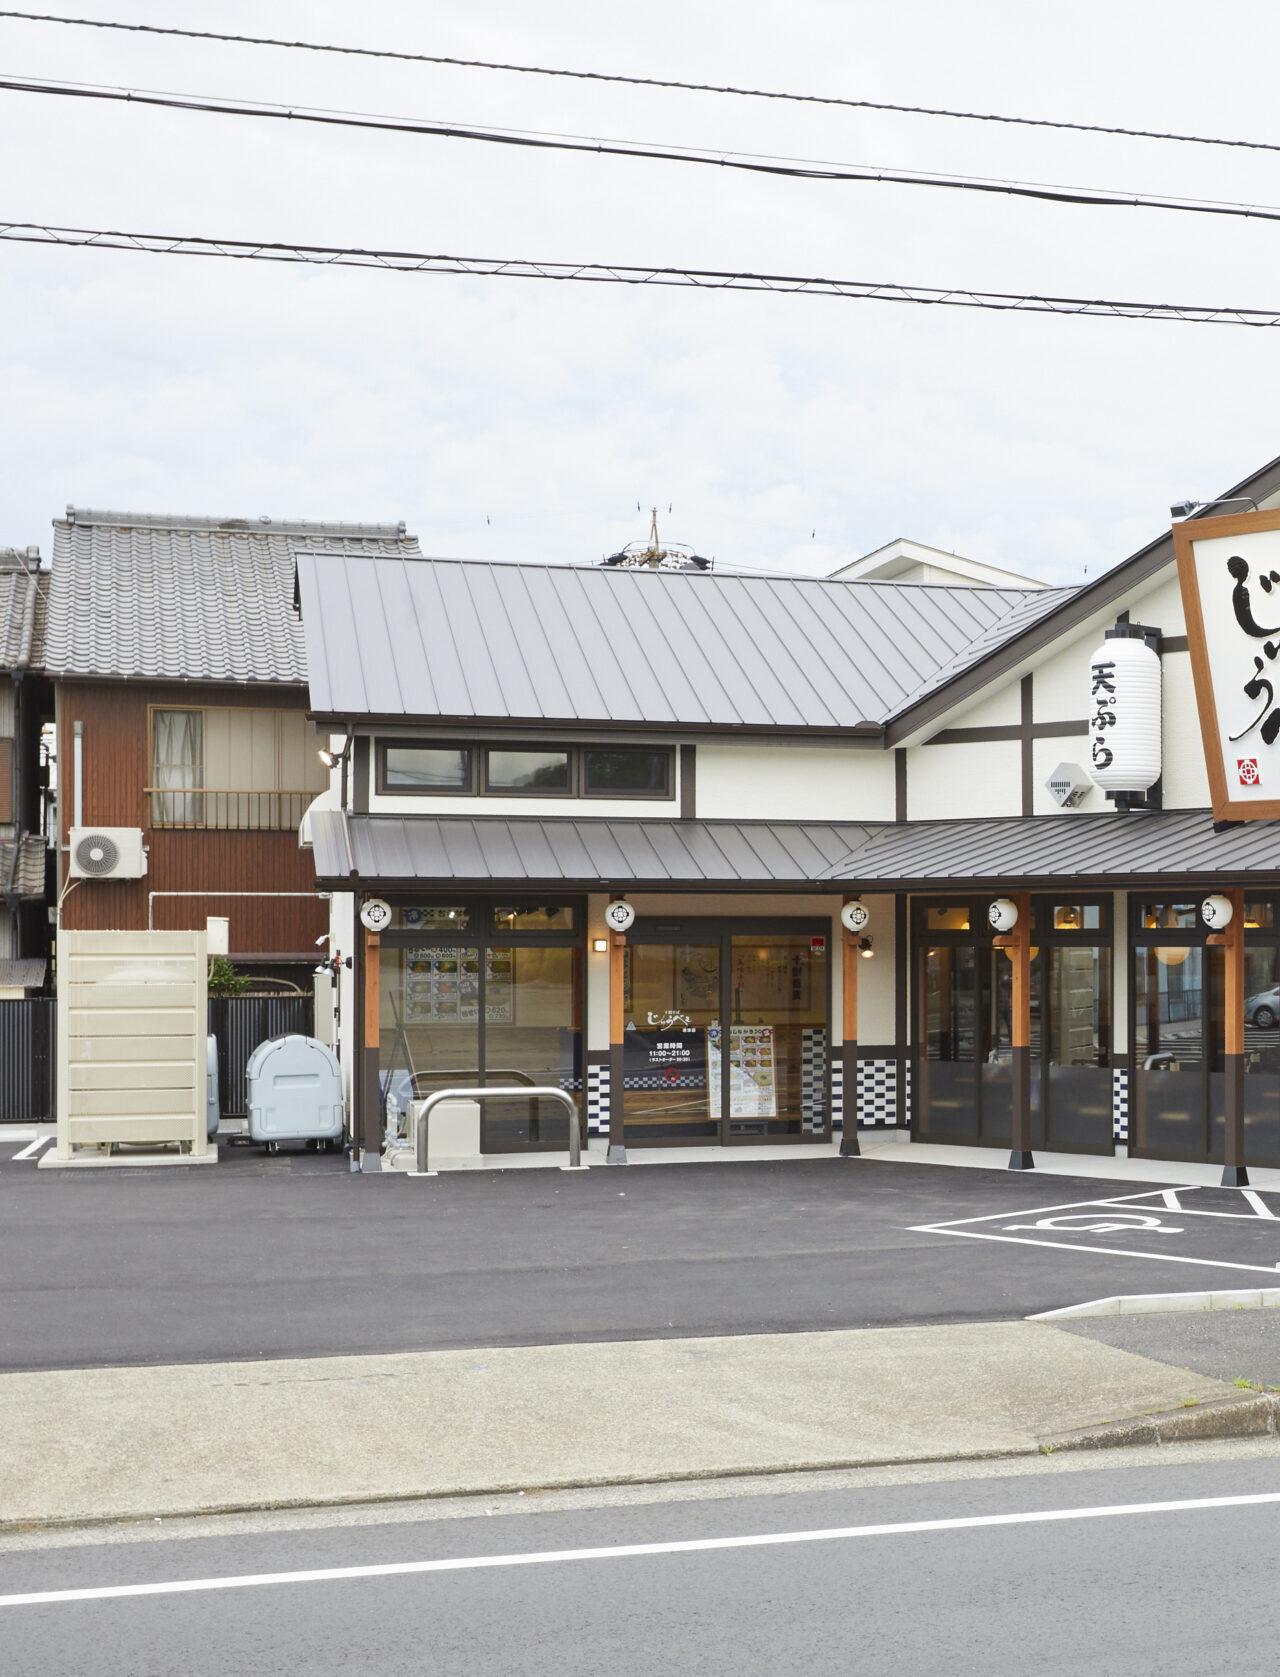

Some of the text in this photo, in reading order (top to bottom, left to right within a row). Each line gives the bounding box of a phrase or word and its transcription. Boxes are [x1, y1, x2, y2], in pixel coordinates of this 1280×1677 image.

[1090, 660, 1117, 770] 天ぷら
[656, 1042, 683, 1050] 営業時間
